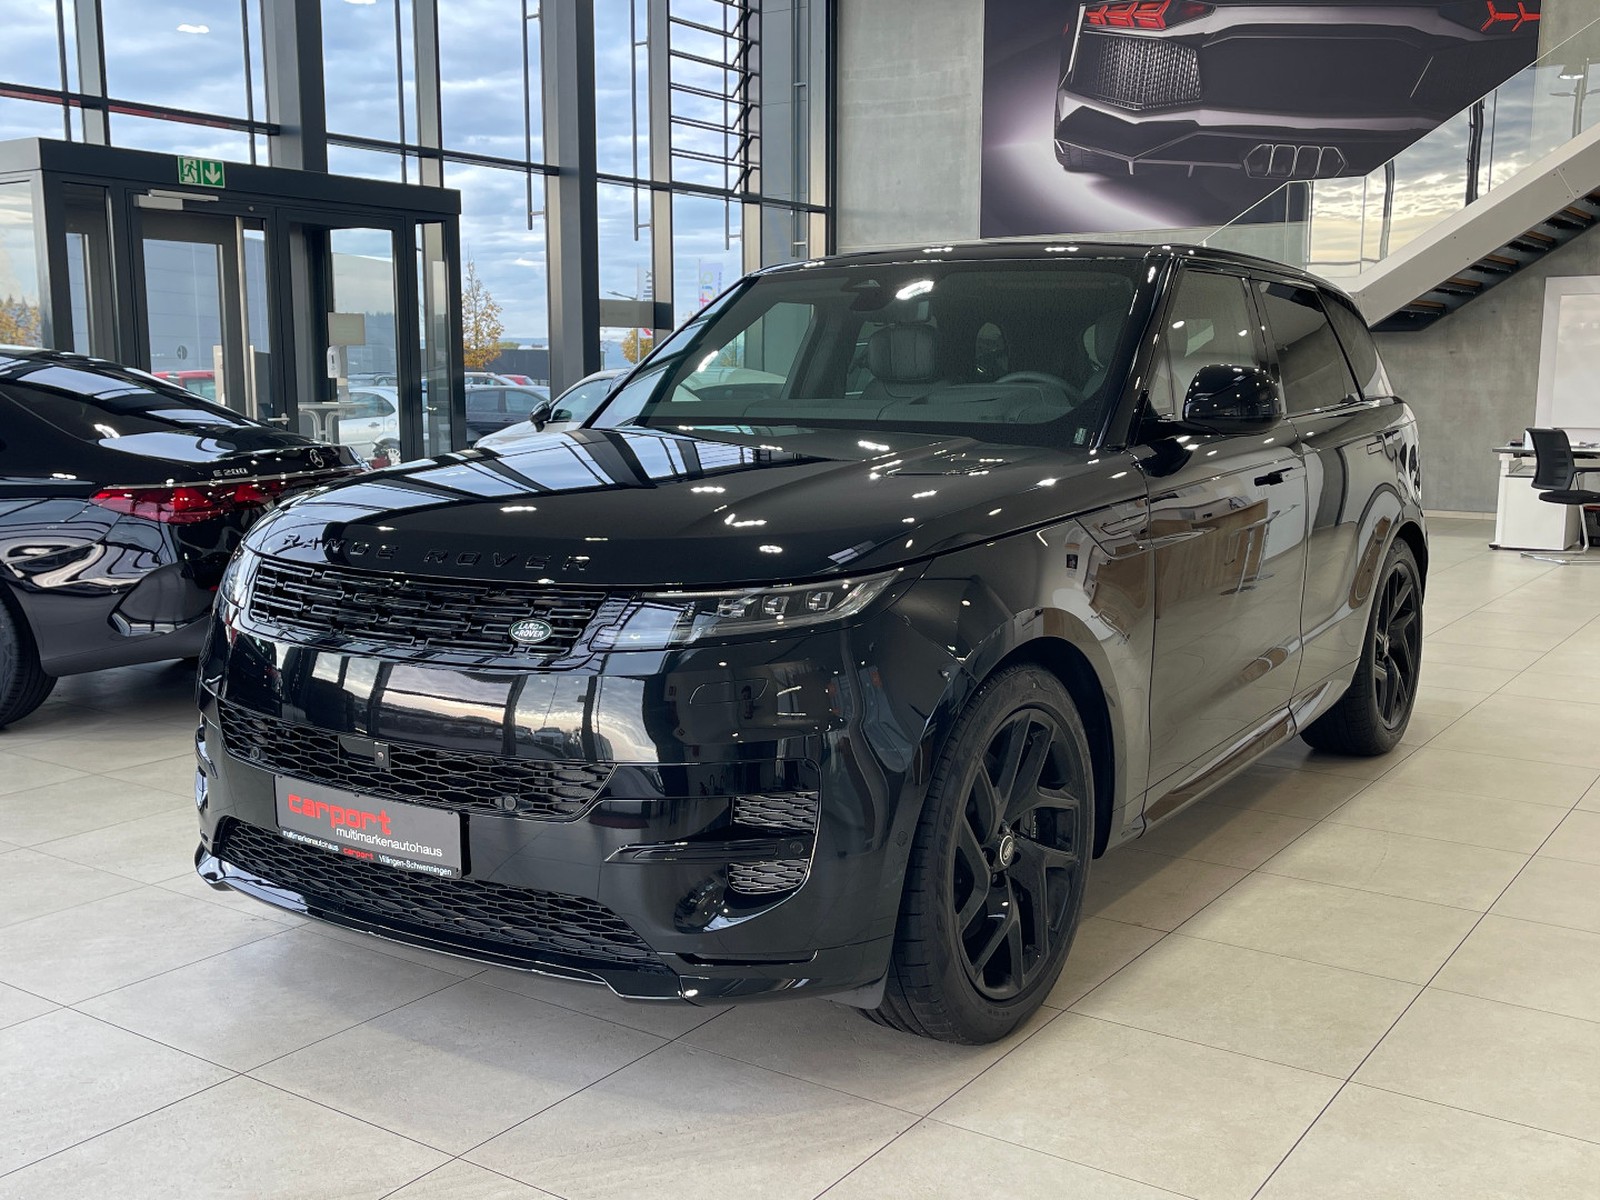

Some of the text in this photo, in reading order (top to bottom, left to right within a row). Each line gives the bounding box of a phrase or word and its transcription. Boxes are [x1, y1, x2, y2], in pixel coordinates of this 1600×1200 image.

[213, 467, 248, 477] E 200
[285, 533, 591, 571] RANGE ROVER
[518, 622, 540, 630] LAND
[288, 794, 391, 835] carport
[282, 830, 452, 876] multimarkenautohaus carport Villingen-Schwenningen
[336, 827, 443, 857] multimarkenautohaus
